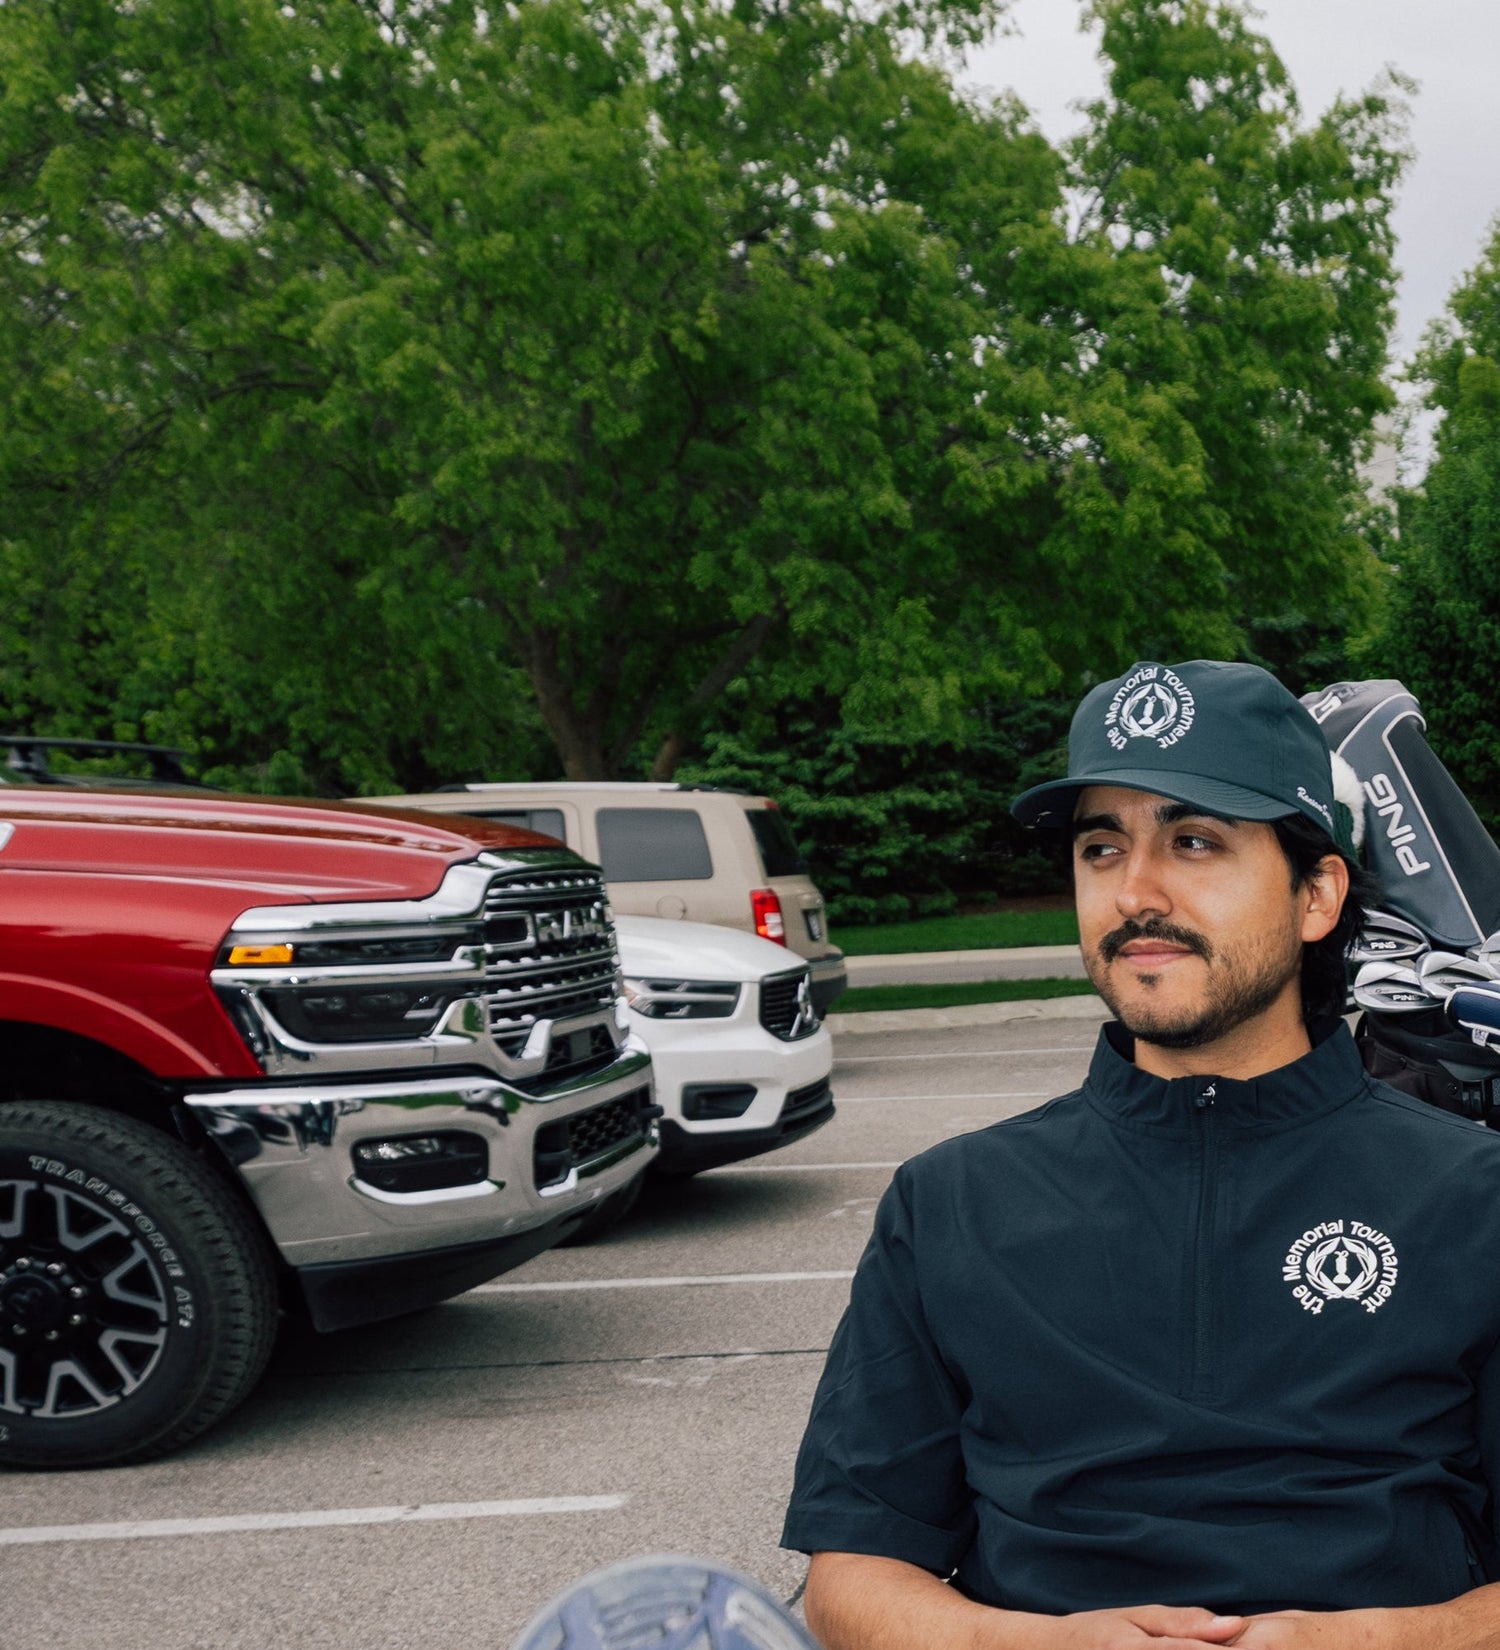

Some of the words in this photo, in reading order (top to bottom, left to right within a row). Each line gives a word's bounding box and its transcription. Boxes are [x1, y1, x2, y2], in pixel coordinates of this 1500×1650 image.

[1104, 667, 1158, 725] Memorial
[1156, 668, 1195, 749] Tournament
[1107, 727, 1128, 750] the
[1363, 773, 1431, 876] PING
[1370, 941, 1397, 950] PING
[28, 1155, 185, 1277] TRANSFORCE
[1282, 1219, 1344, 1281] Memorial
[1350, 1221, 1398, 1314] Tournament
[1292, 1284, 1325, 1315] the
